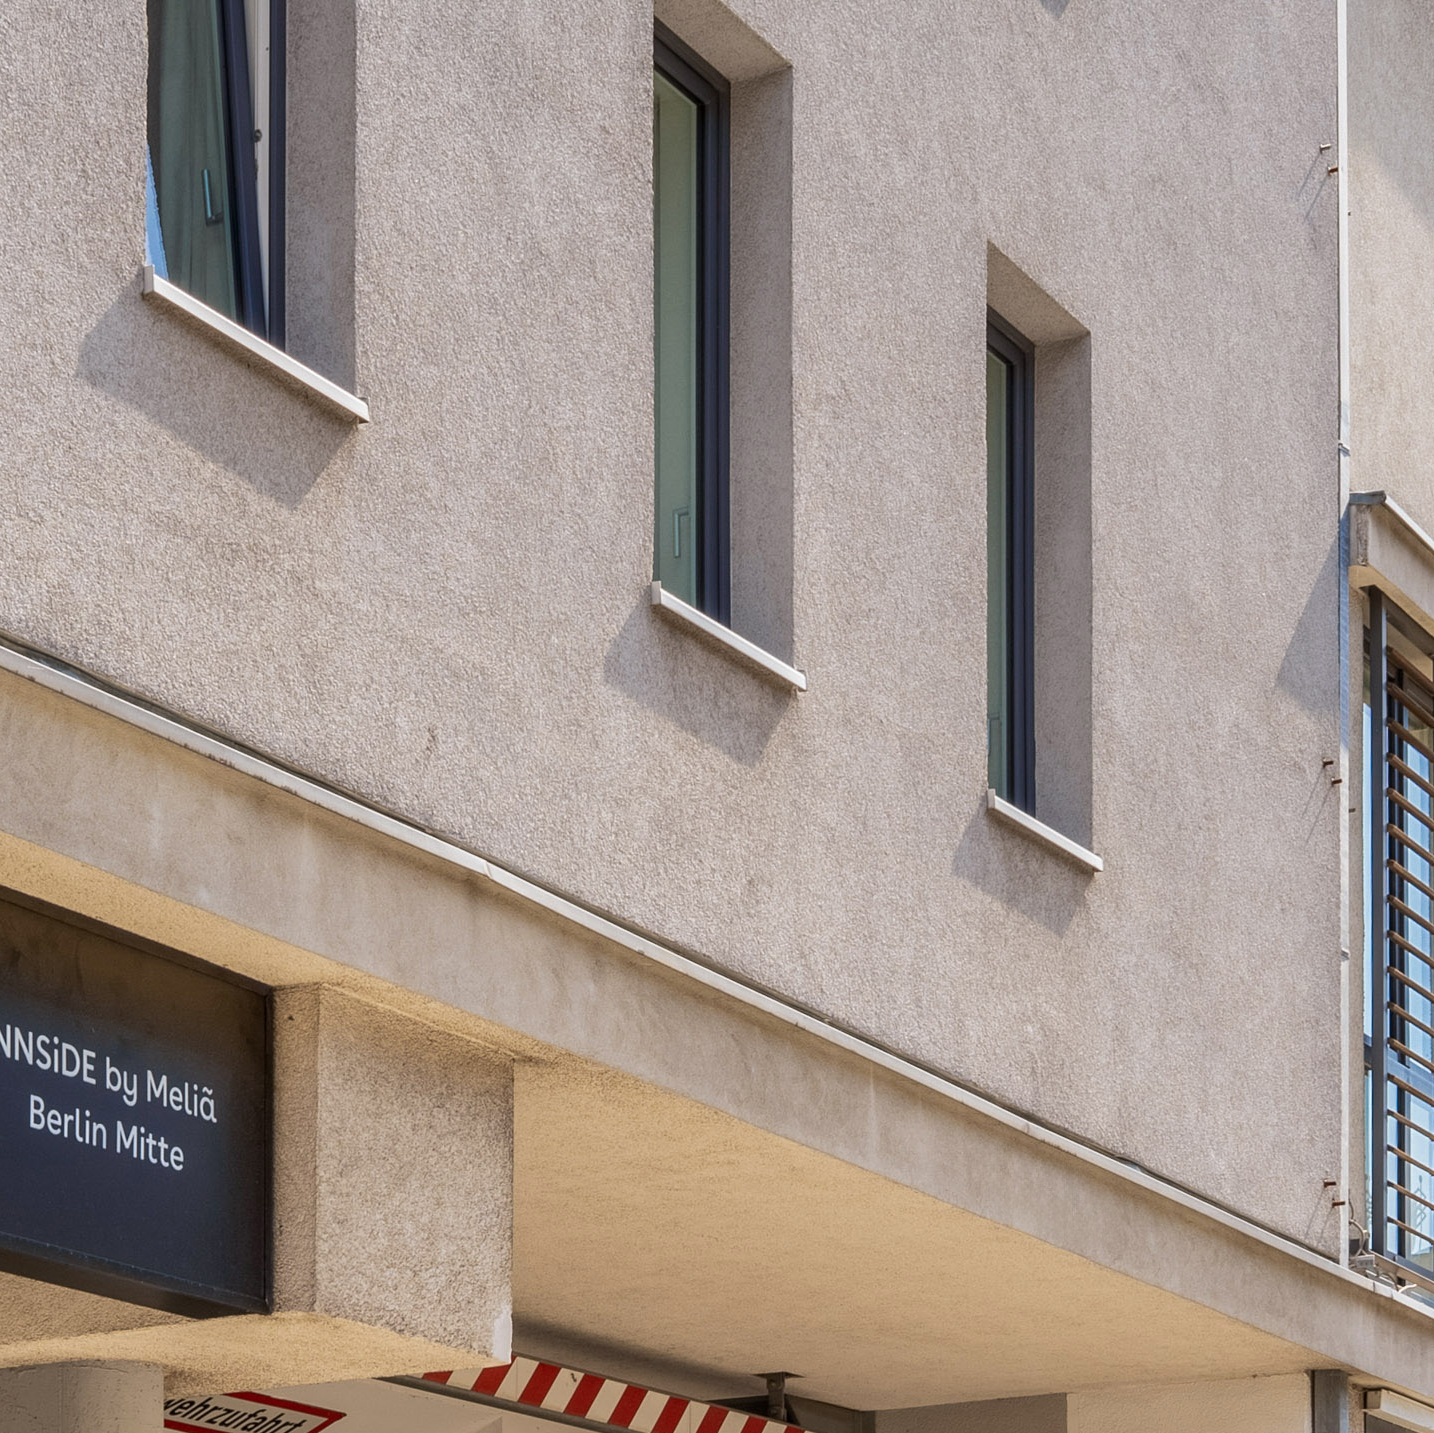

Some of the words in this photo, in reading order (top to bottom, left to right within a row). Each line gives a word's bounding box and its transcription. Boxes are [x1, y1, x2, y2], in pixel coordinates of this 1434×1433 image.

[105, 1056, 138, 1106] by
[29, 1094, 107, 1149] Berlin
[116, 1120, 184, 1171] Mitte
